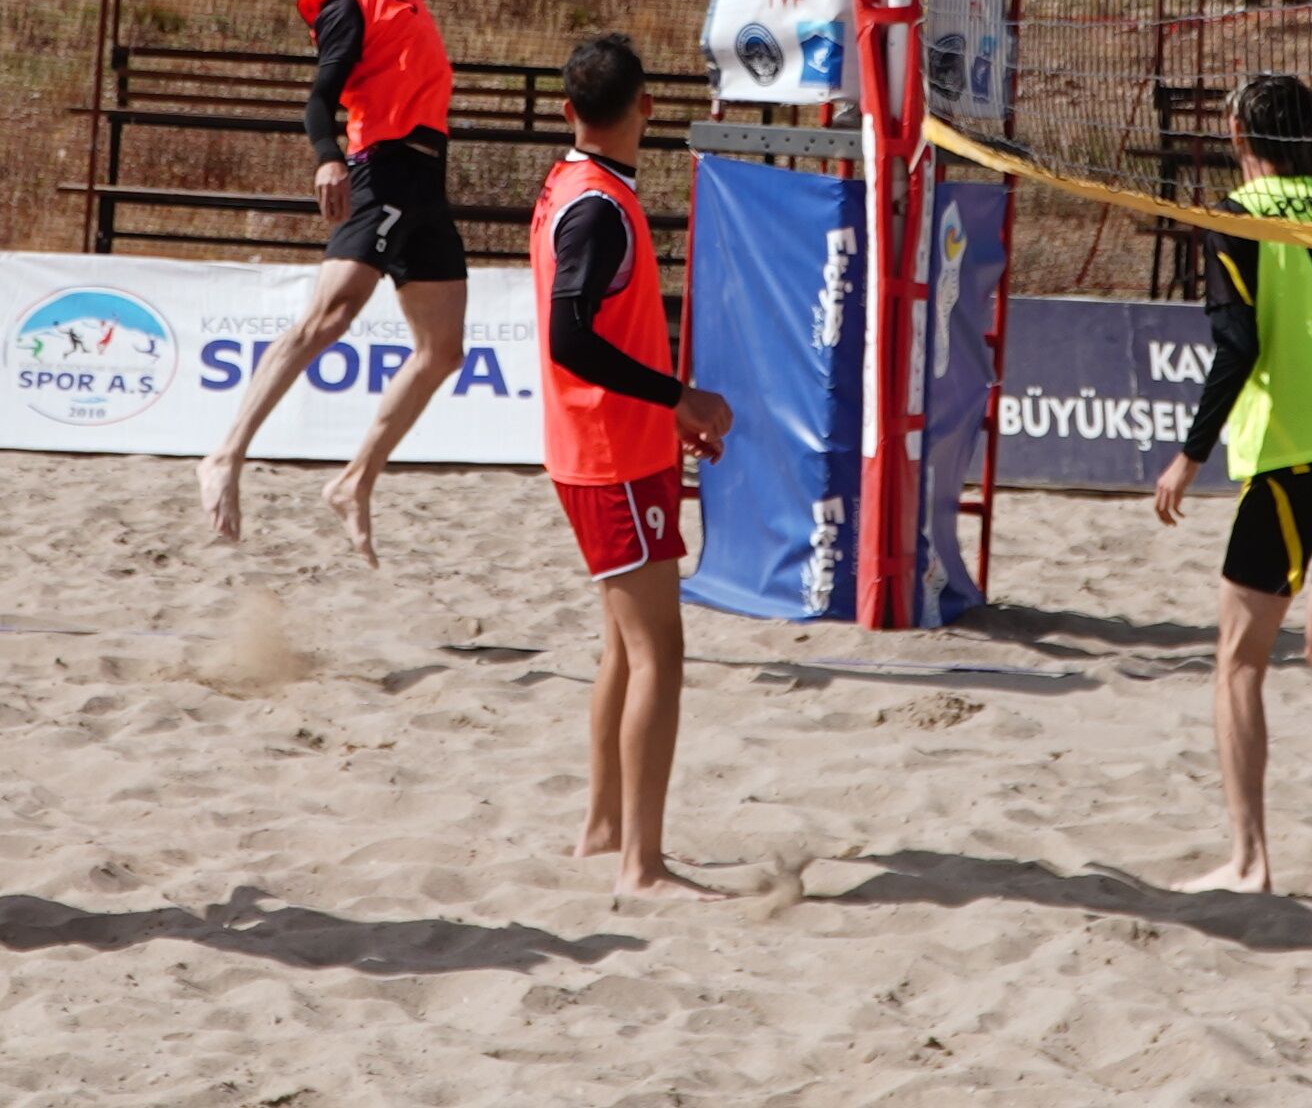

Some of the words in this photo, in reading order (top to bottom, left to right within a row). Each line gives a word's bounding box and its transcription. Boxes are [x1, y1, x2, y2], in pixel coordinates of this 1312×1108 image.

[376, 204, 403, 237] 7
[818, 226, 858, 347] Erciyes
[199, 338, 417, 394] SOR
[18, 370, 95, 392] SPOR
[107, 373, 161, 398] A.Ş.
[645, 505, 667, 540] 9
